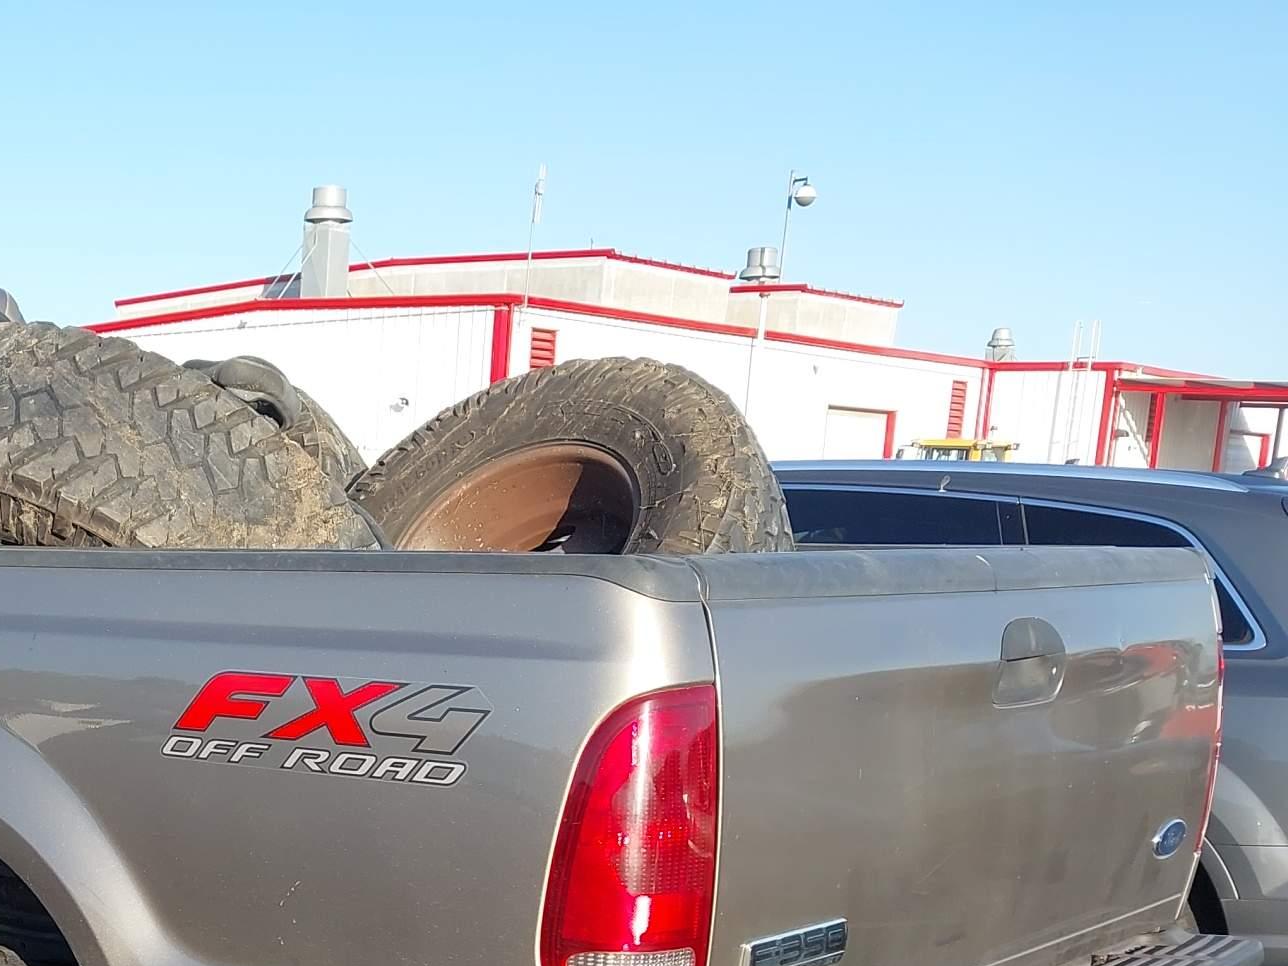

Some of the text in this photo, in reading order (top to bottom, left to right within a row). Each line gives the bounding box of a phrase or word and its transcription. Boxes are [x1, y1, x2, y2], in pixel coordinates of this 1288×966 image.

[173, 671, 492, 755] FX4
[162, 734, 466, 787] OFF ROAD
